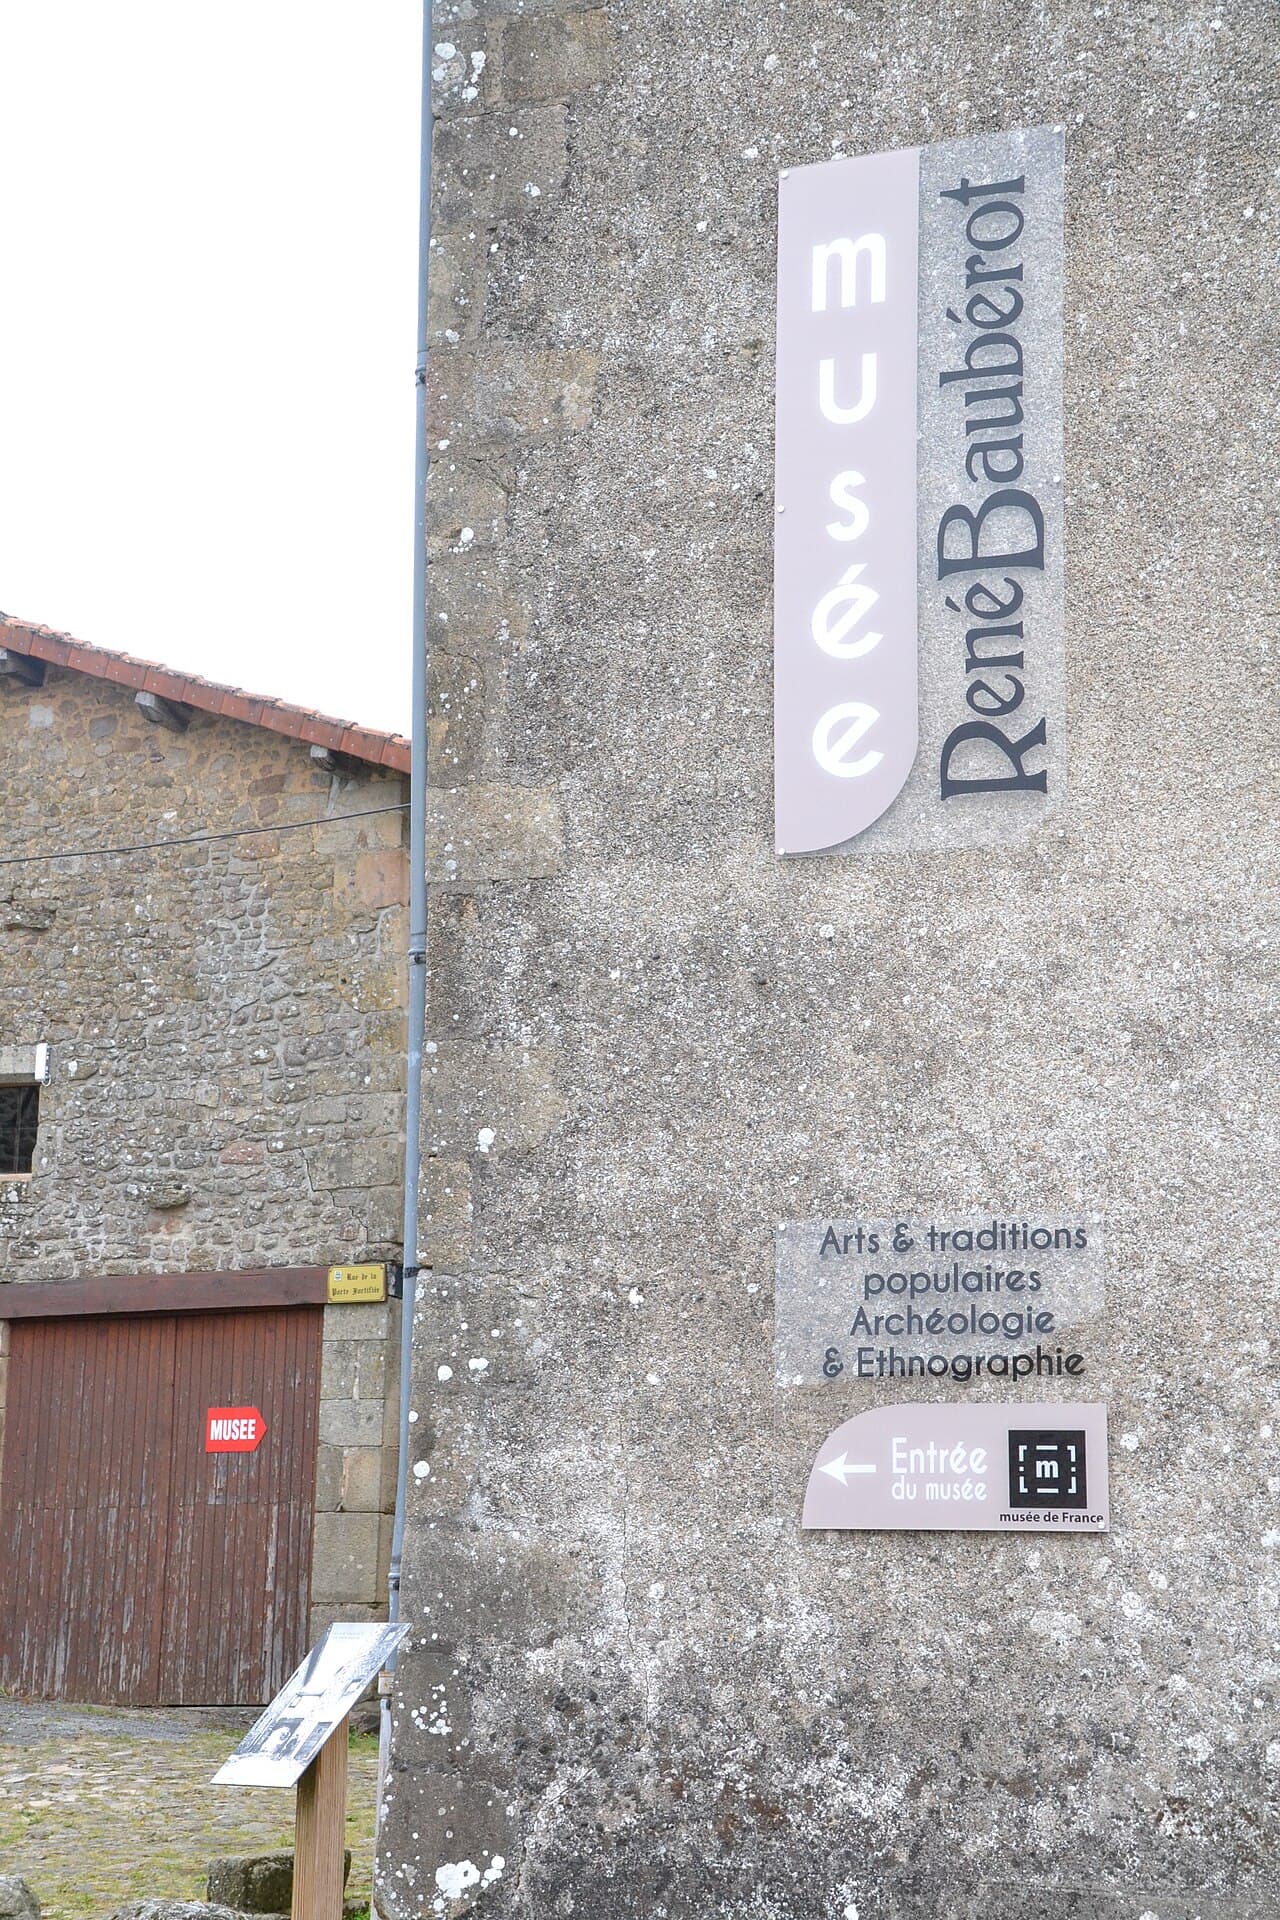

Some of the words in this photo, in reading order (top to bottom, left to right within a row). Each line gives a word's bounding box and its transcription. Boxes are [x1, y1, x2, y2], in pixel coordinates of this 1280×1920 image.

[811, 231, 886, 779] musée
[819, 1225, 880, 1255] Arts
[892, 1223, 914, 1252] &
[927, 1220, 1088, 1251] traditions
[864, 1262, 1042, 1300] populaires
[850, 1304, 1056, 1339] Archéologie
[822, 1347, 844, 1378] &
[857, 1345, 1086, 1382] Ethnographie
[210, 1418, 256, 1441] MUSEE
[891, 1437, 988, 1474] Entrée
[891, 1476, 917, 1500] du
[925, 1477, 988, 1500] musée
[999, 1512, 1040, 1523] musée
[1043, 1511, 1060, 1523] de
[1062, 1511, 1104, 1524] France
